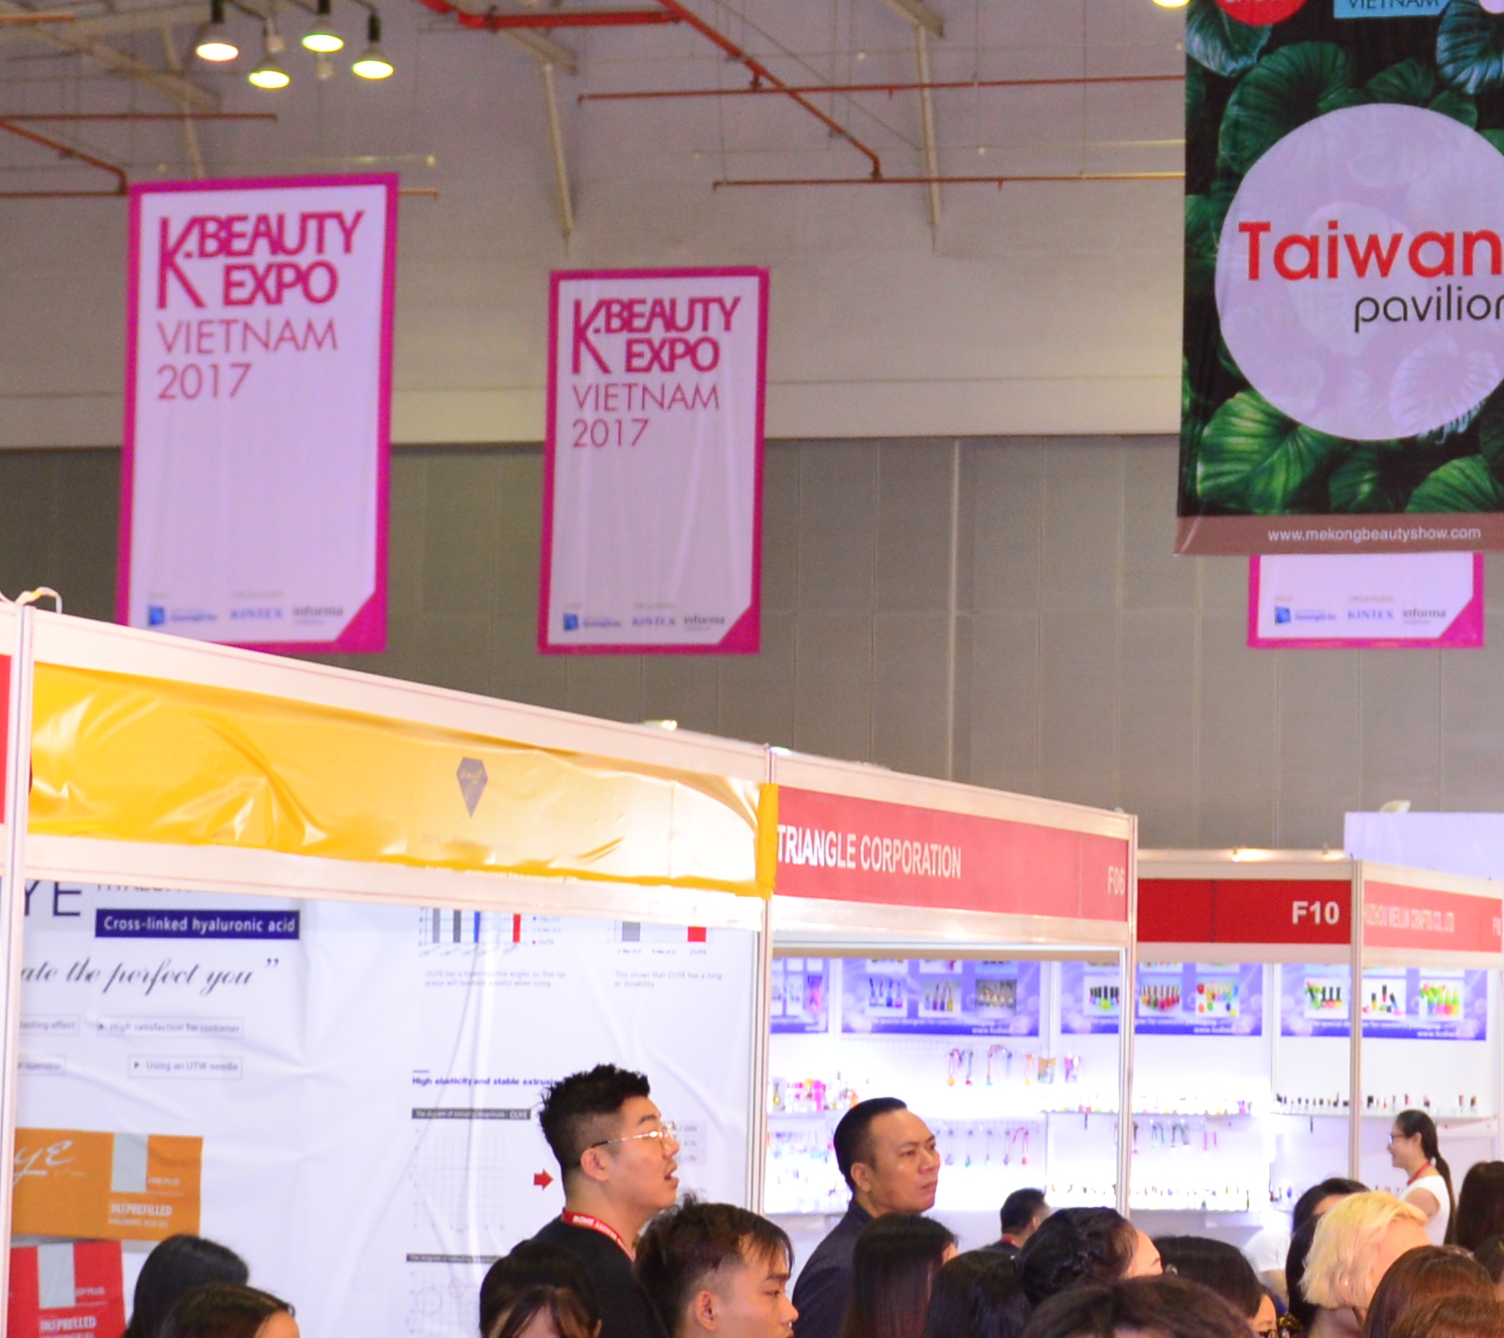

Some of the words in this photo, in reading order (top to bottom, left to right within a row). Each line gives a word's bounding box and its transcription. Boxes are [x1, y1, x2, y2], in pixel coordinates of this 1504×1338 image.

[1238, 220, 1503, 281] Taiwan
[222, 261, 338, 305] EXPO
[157, 318, 338, 354] VIETNAM
[624, 338, 721, 373] EXPO
[156, 363, 252, 400] 2017
[572, 383, 719, 411] VIETNAM
[571, 418, 649, 449] 2017
[1268, 526, 1482, 544] www.mekongbeautyshow.com
[777, 824, 856, 869] TRIANGLE
[860, 835, 961, 879] CORPORATION
[1107, 866, 1126, 896] F06
[104, 915, 187, 932] Cross-linked
[192, 916, 263, 935] hyaluronic
[268, 917, 295, 932] acid
[1292, 901, 1340, 925] F10
[66, 956, 101, 984] the
[102, 958, 200, 996] perfect
[493, 1077, 519, 1086] stable
